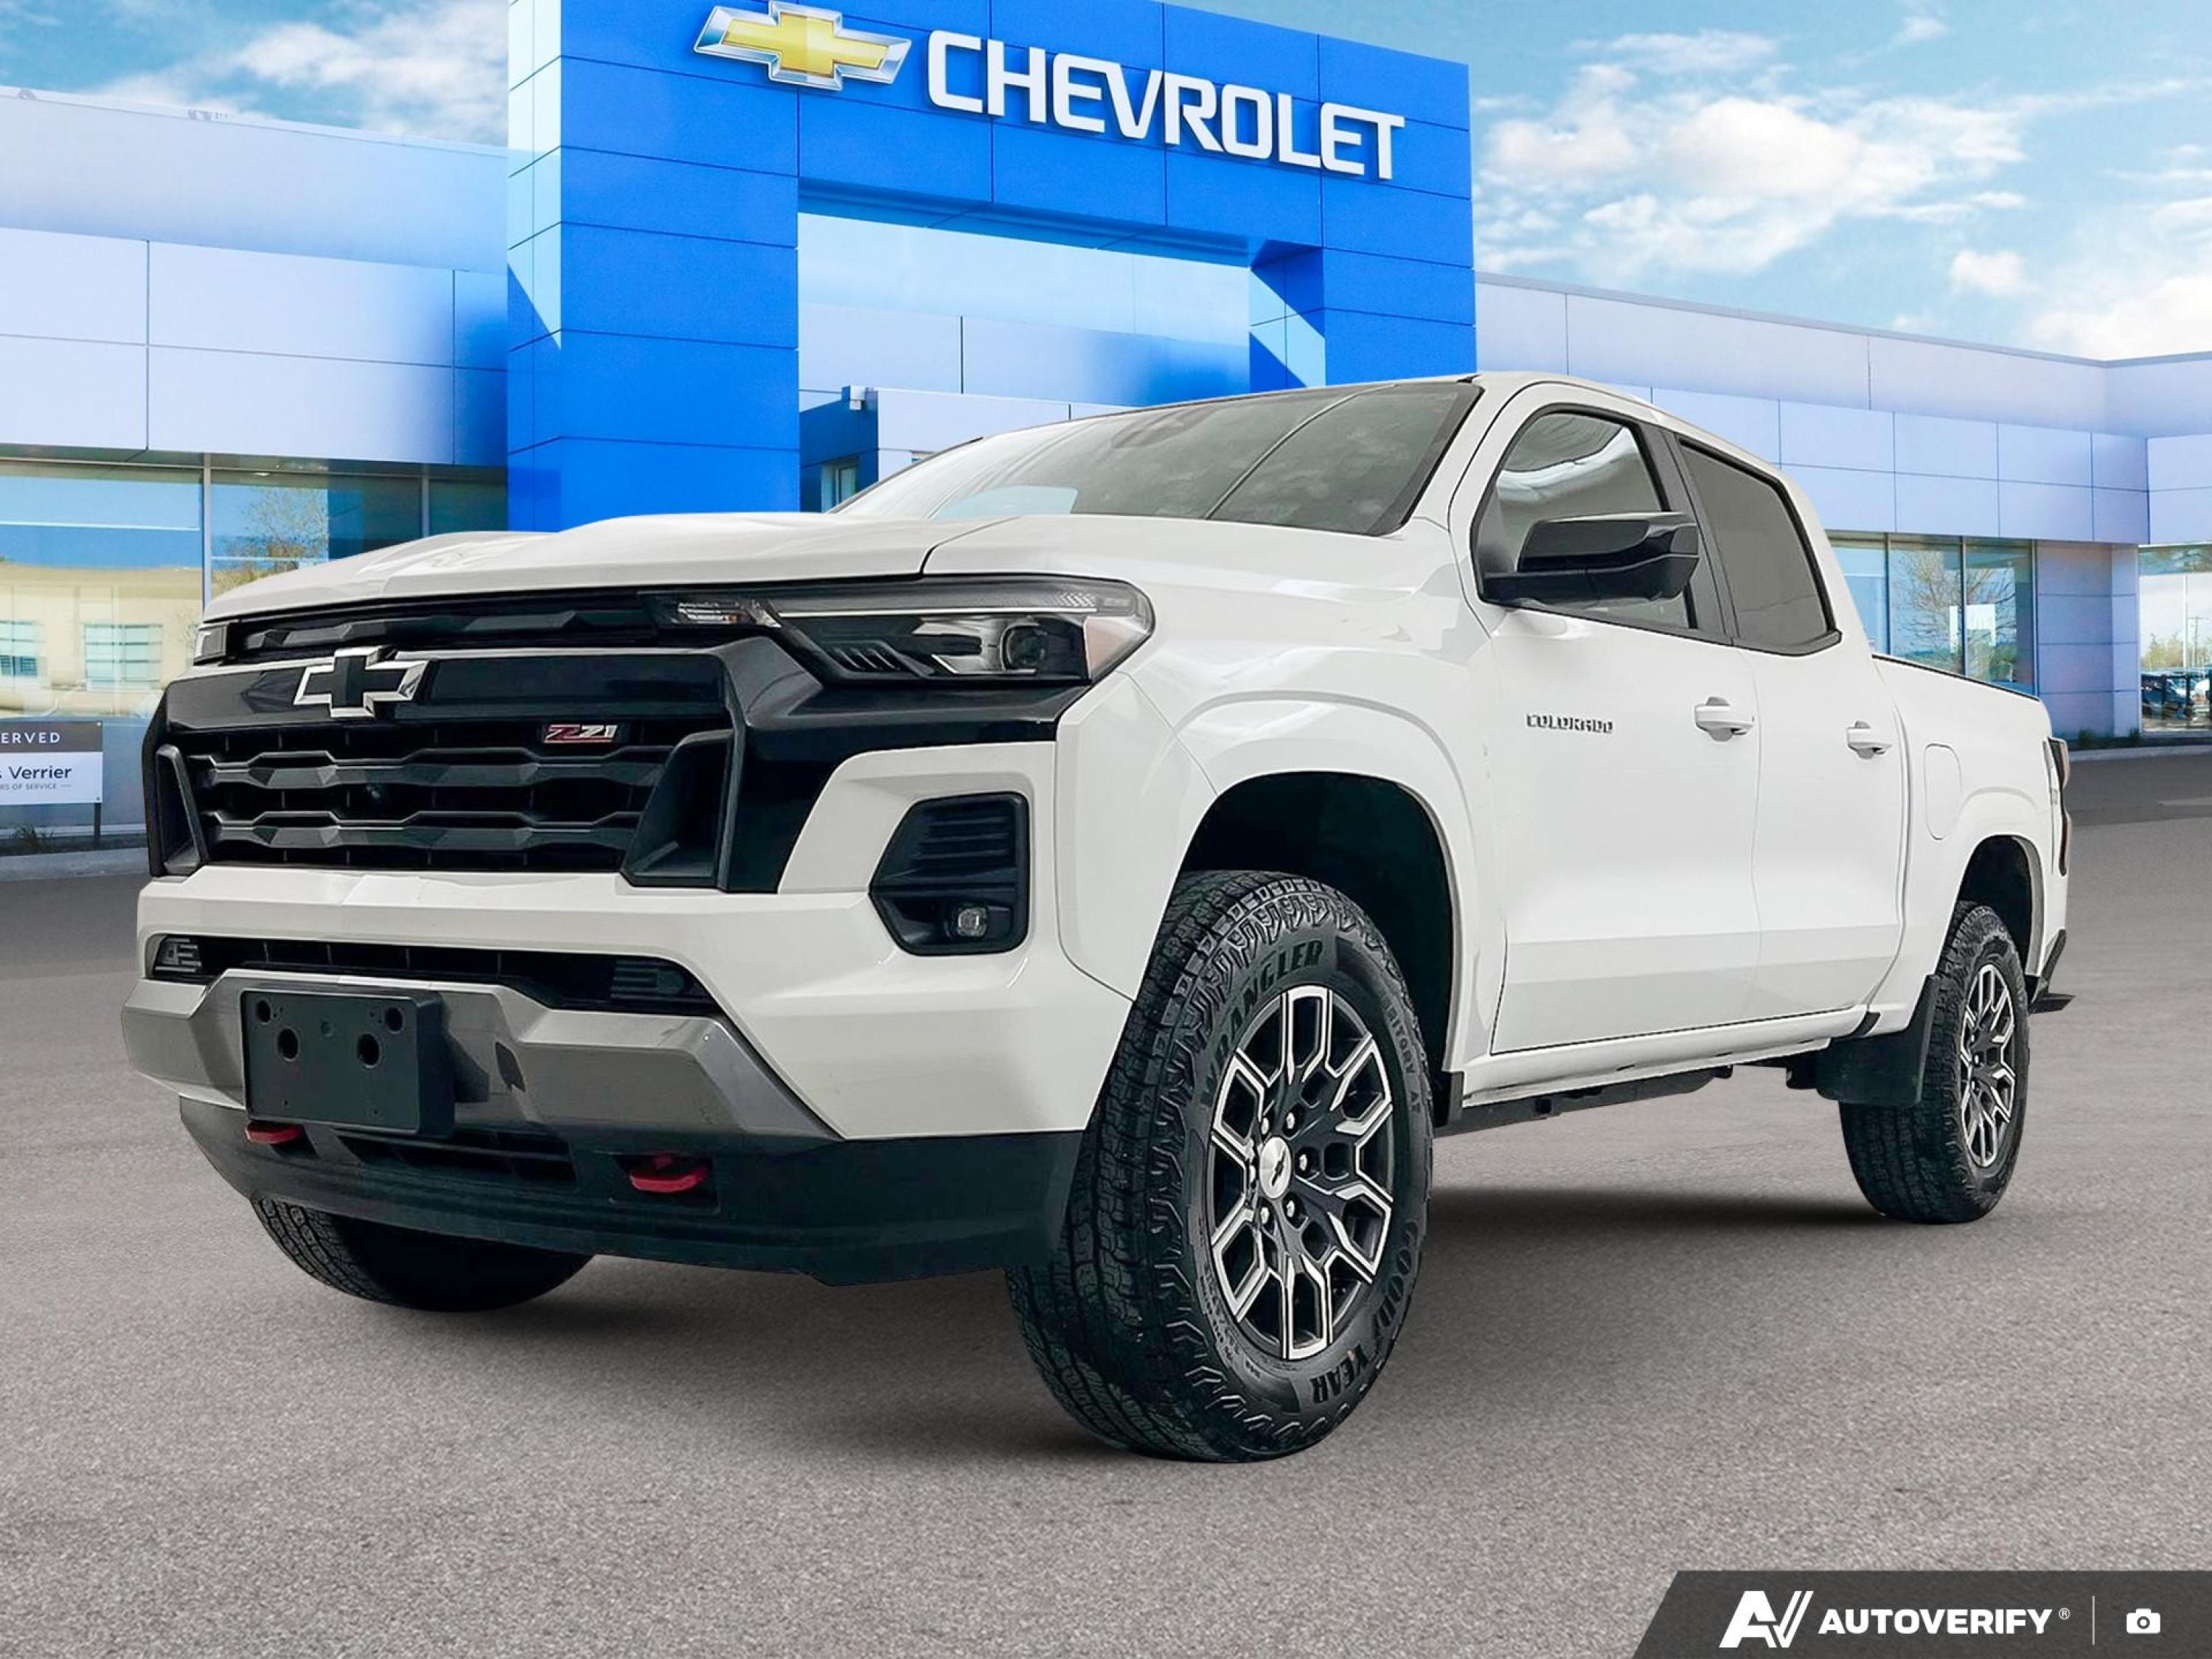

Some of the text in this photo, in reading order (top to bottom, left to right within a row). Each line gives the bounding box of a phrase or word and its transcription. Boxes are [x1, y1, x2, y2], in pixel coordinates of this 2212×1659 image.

[928, 29, 1405, 181] CHEVROLET
[545, 724, 618, 743] Z71
[1526, 713, 1613, 734] COLORADO
[8, 765, 72, 779] Verrier
